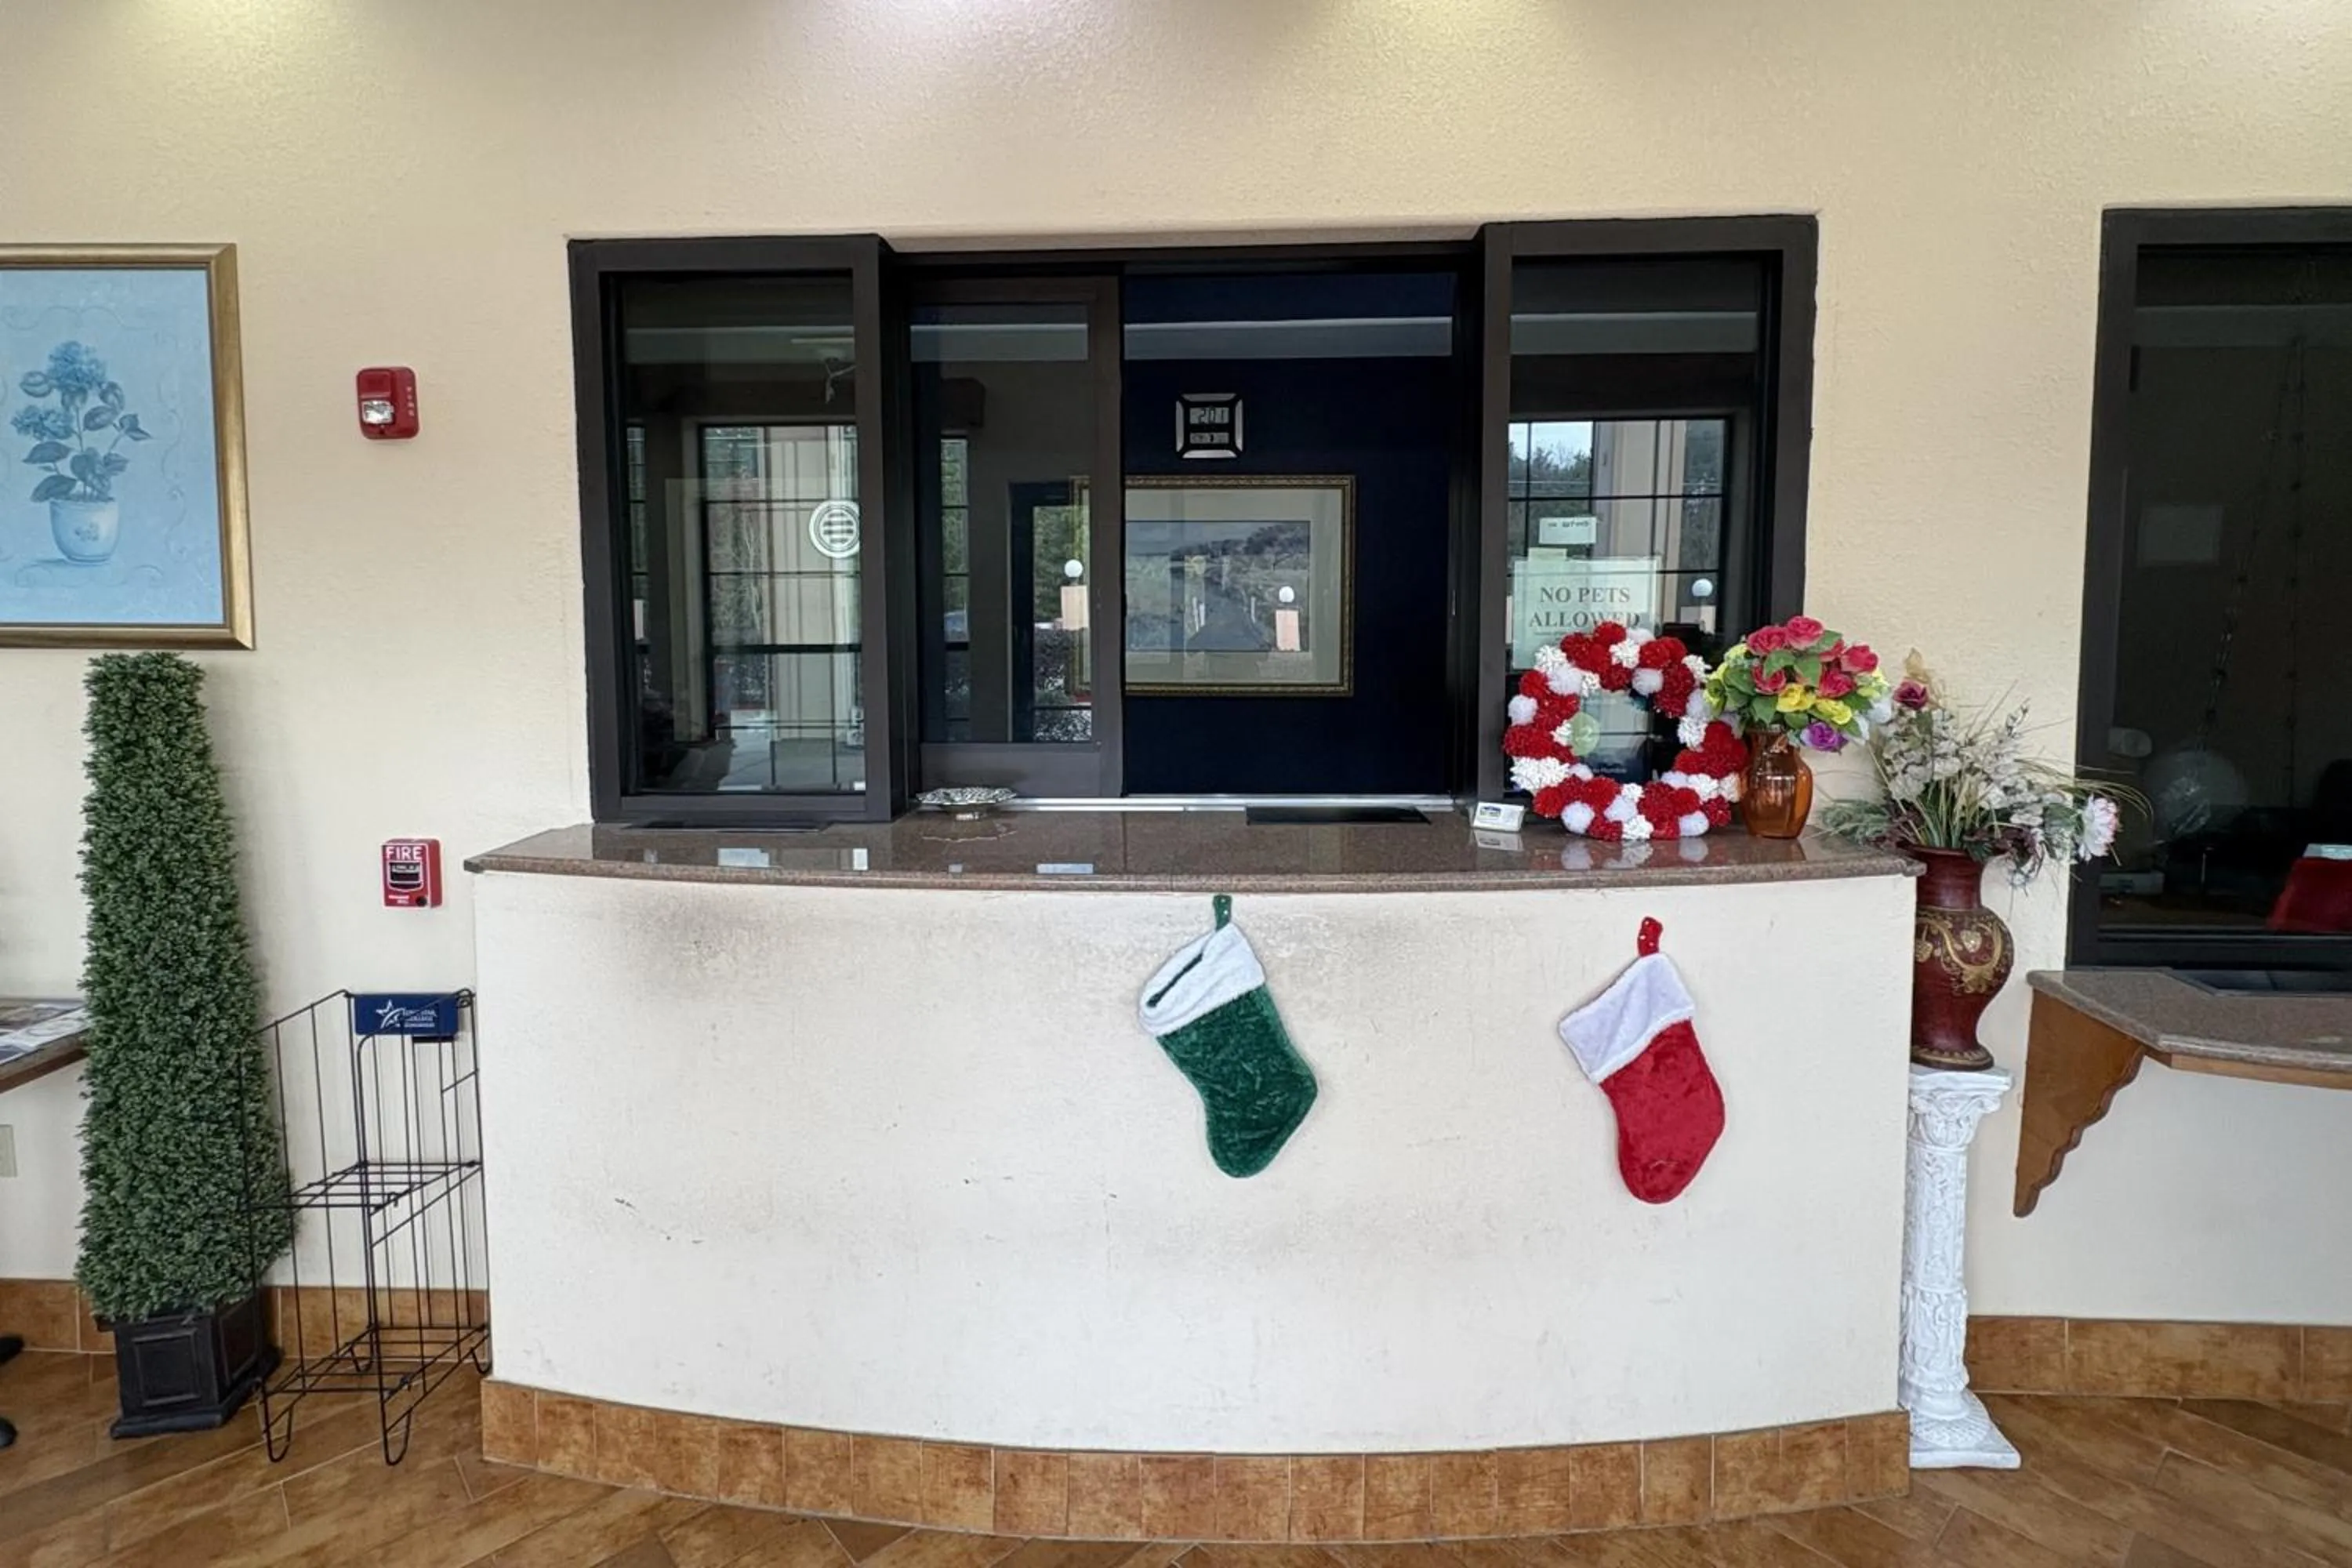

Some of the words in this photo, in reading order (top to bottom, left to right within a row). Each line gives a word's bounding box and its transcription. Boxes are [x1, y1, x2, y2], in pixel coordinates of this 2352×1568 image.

[1540, 587, 1571, 603] NO
[1578, 587, 1630, 603] PETS
[386, 846, 423, 860] FIRE
